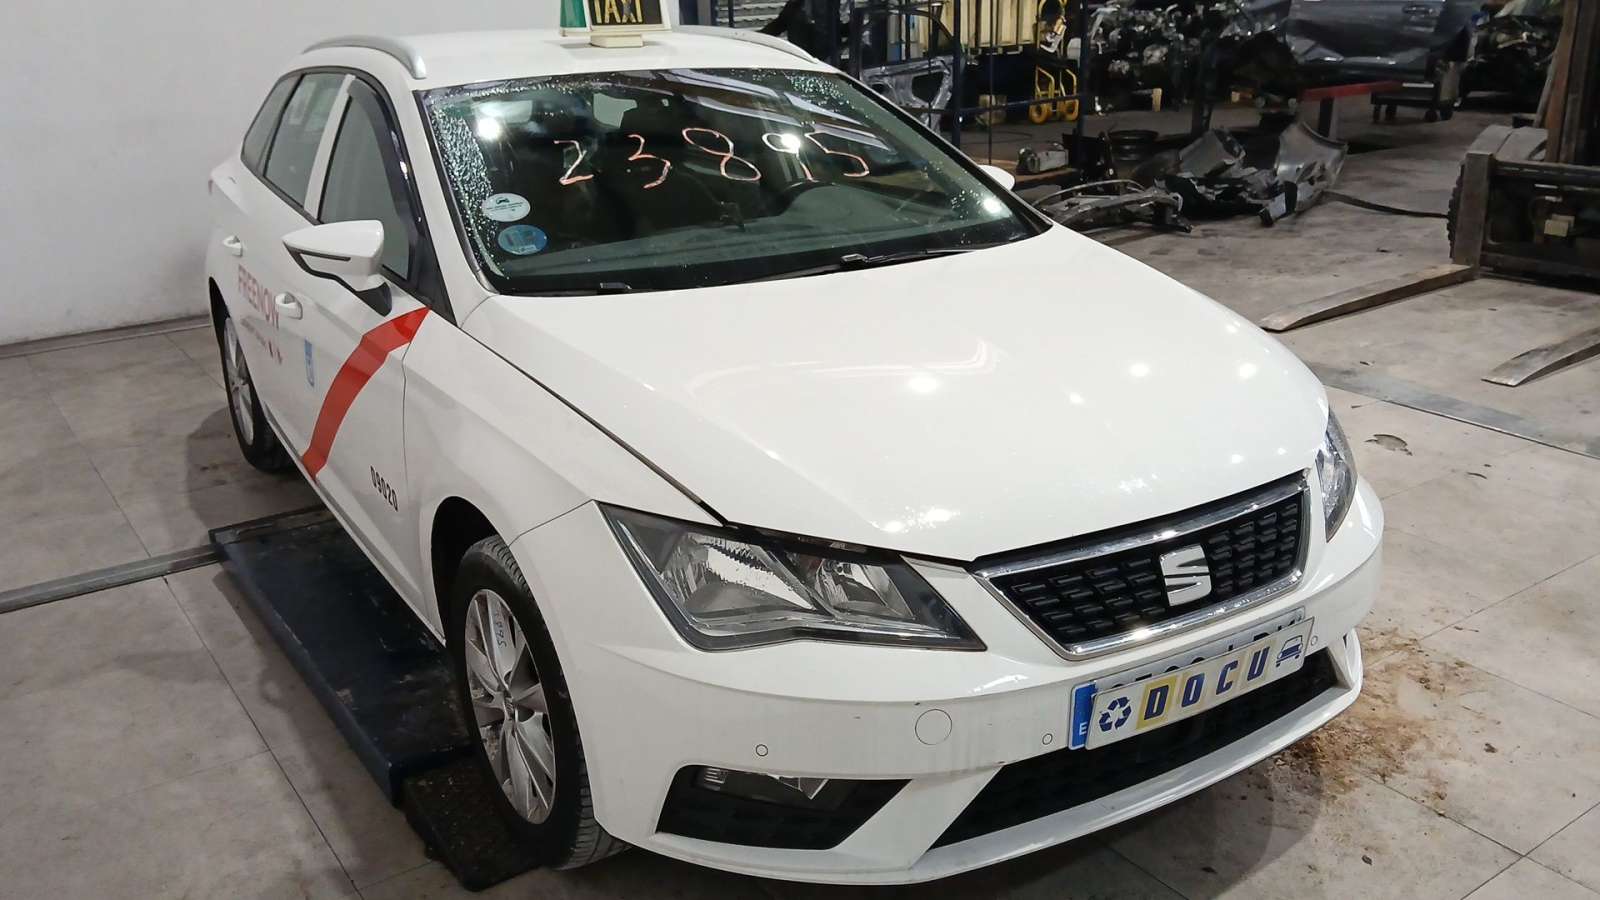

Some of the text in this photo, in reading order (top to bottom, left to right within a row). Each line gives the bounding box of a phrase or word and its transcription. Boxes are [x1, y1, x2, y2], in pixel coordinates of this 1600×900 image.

[594, 0, 642, 23] TAXI
[1143, 646, 1271, 721] DOCU
[1078, 721, 1088, 735] E
